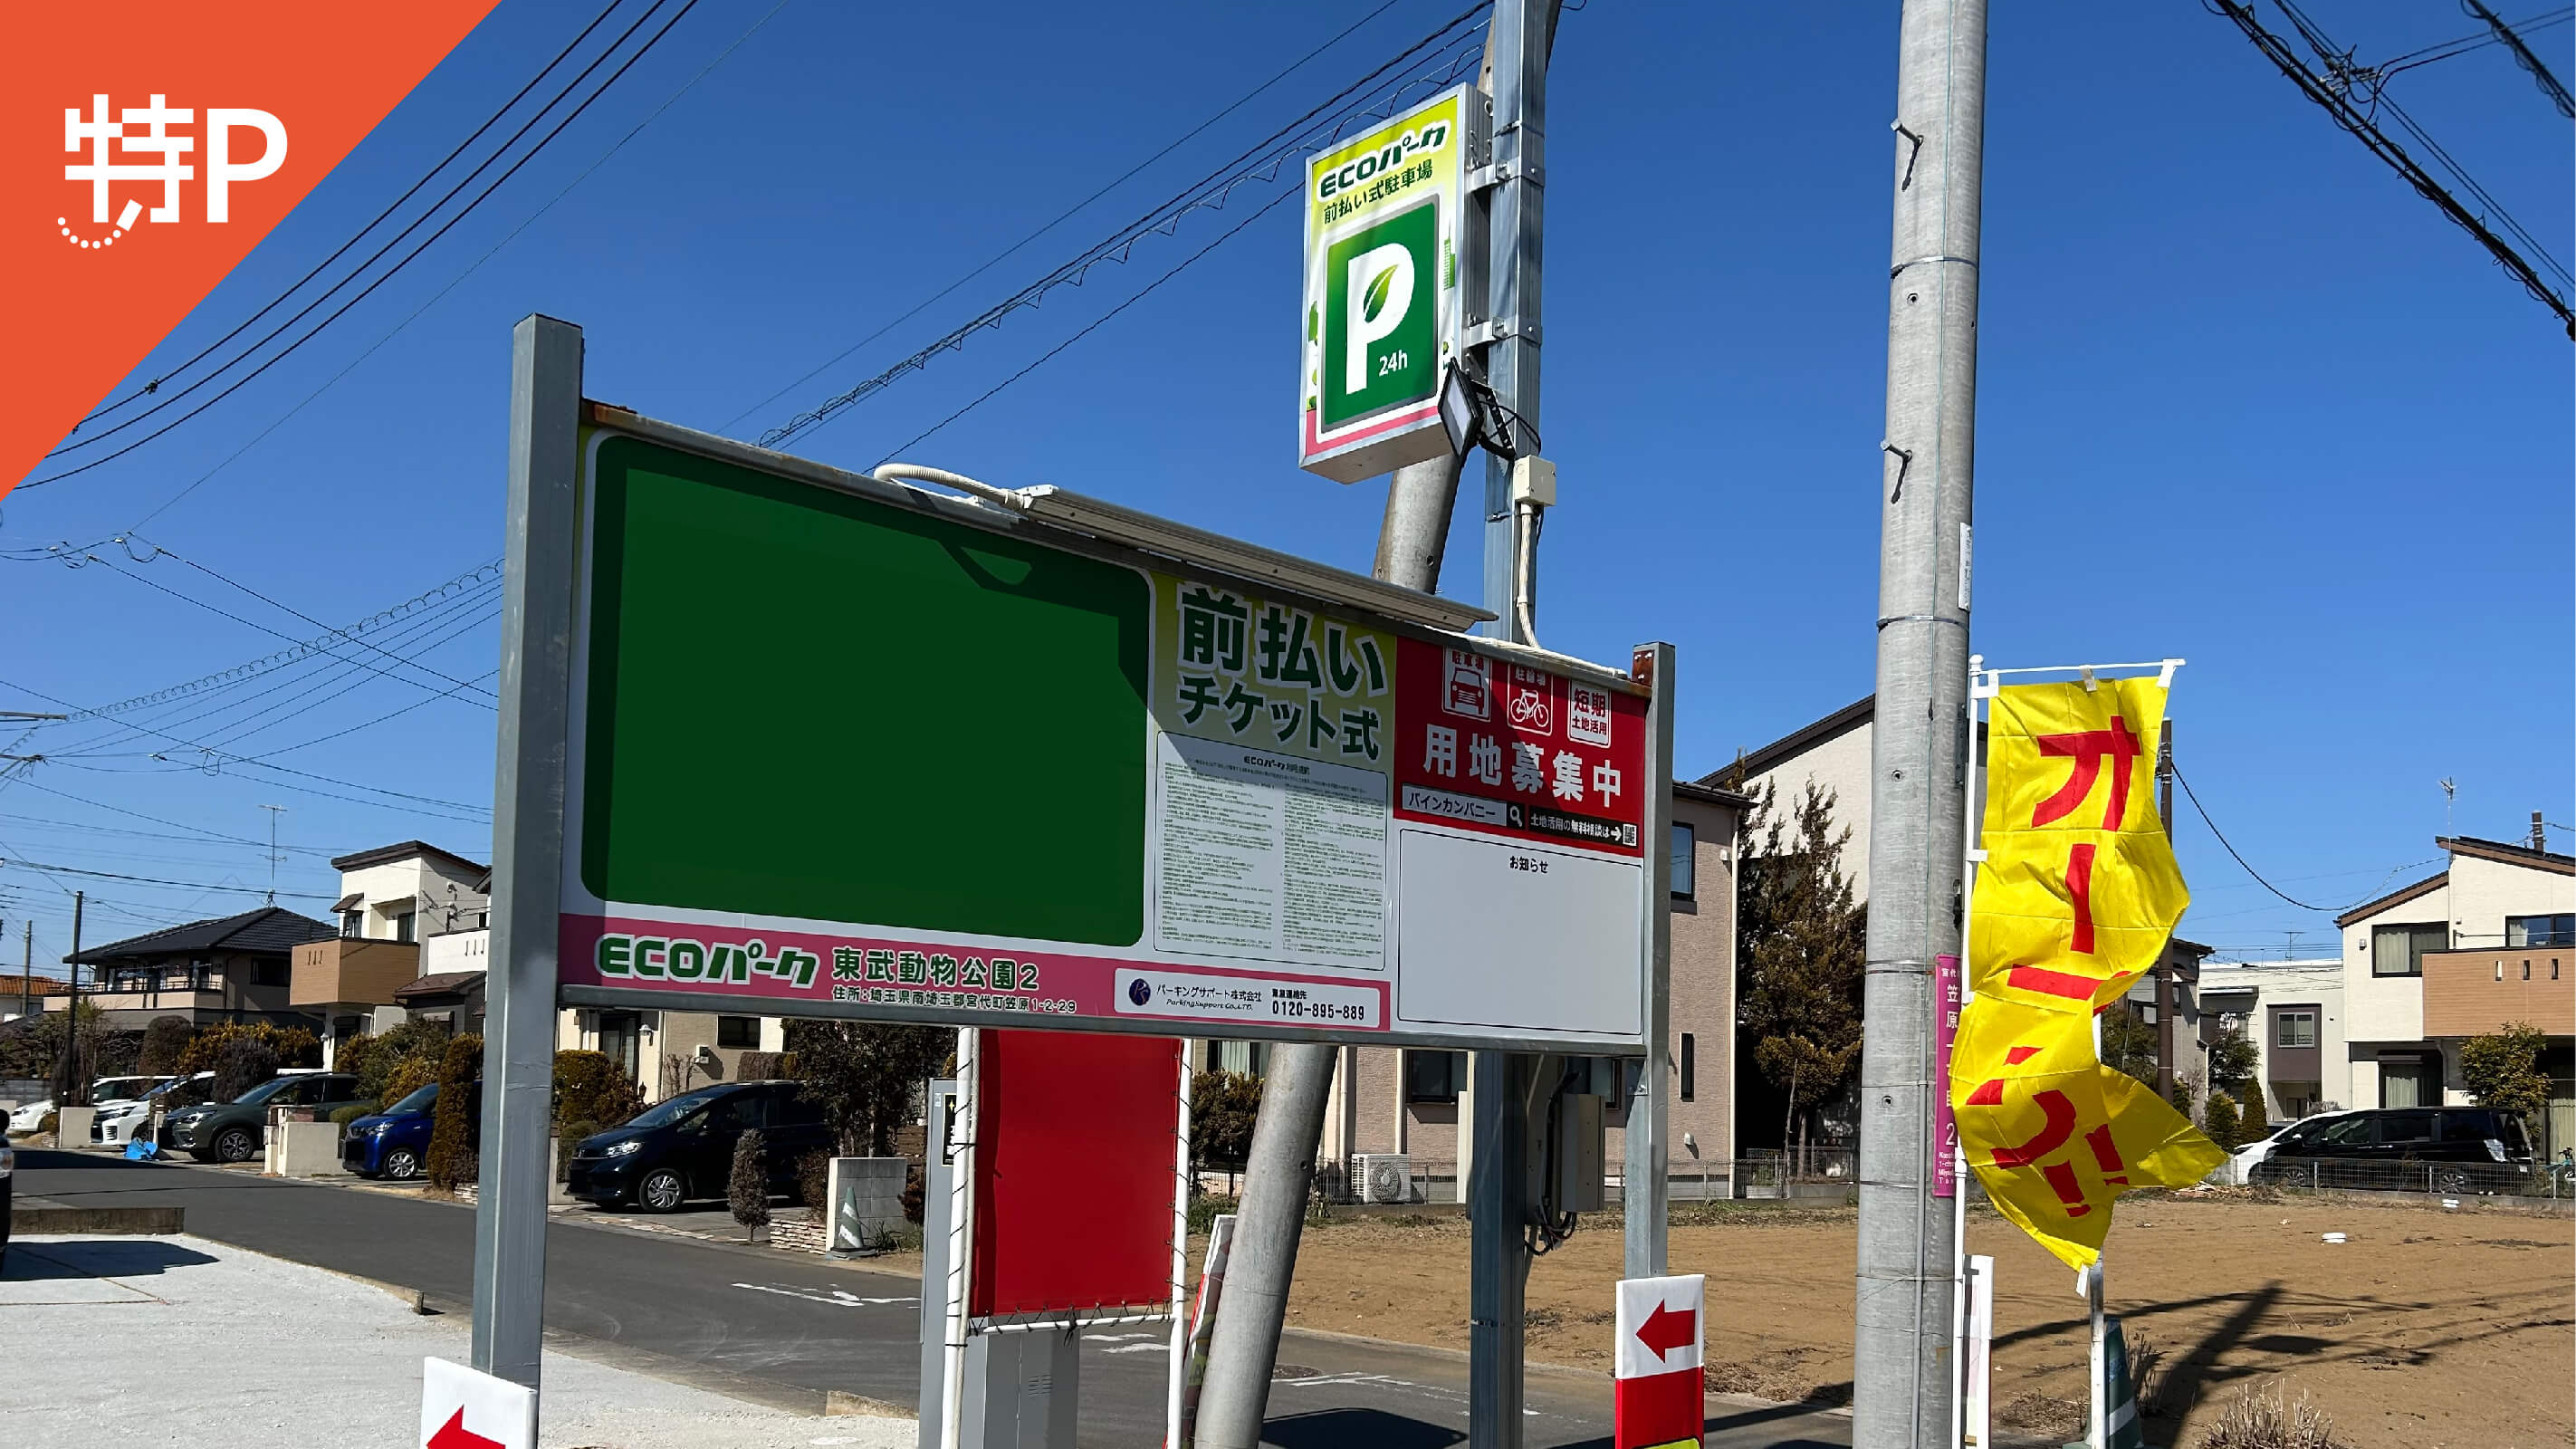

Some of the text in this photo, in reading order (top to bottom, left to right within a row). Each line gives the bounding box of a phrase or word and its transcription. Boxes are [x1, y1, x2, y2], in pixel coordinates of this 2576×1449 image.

[1320, 125, 1446, 197] ECOパーク
[1324, 158, 1432, 225] 前払い式駐車場
[1346, 242, 1415, 396] P
[1379, 350, 1408, 377] 24h
[1181, 587, 1385, 693] 前払い
[1179, 675, 1380, 761] チケット式
[1574, 687, 1606, 718] 短期
[1572, 715, 1607, 735] 土地活用
[1423, 724, 1621, 808] 用地募集中
[1509, 855, 1548, 874] お知らせ
[599, 936, 1039, 990] ECOパーク 東武動物公園2
[1941, 967, 1961, 977] 宮代
[1156, 984, 1262, 1003] パーキングサポート株式会社
[1272, 1000, 1365, 1021] 0120-895-889
